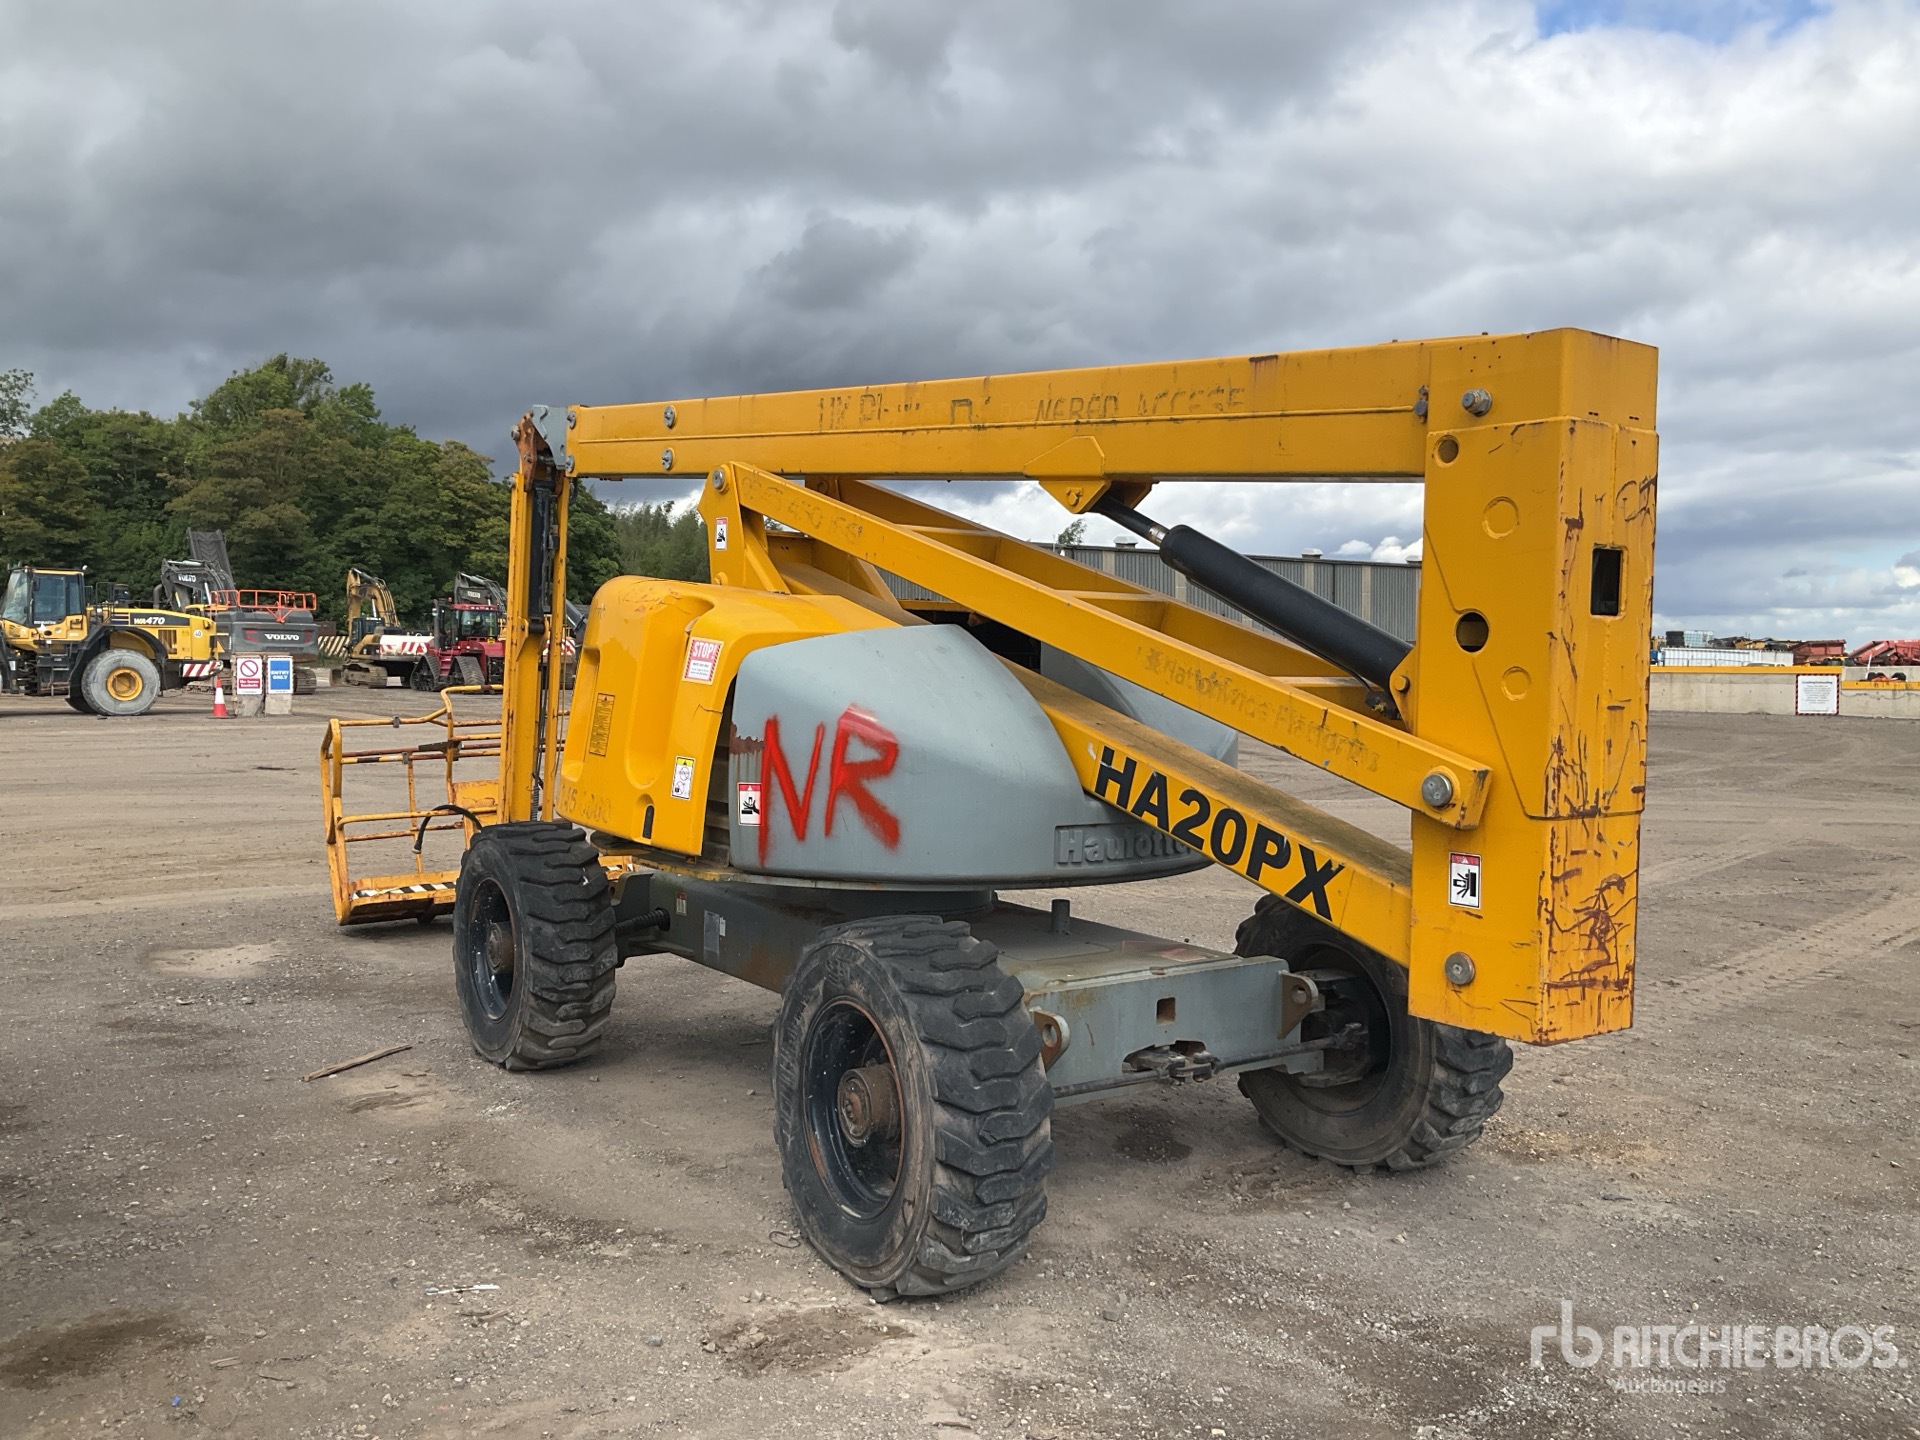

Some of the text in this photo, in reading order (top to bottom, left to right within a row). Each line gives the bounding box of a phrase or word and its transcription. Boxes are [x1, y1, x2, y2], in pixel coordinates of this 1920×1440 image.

[178, 574, 197, 583] VOLVO
[133, 616, 166, 625] WA470
[264, 633, 300, 641] VOLVO
[692, 641, 718, 660] STOP!
[758, 702, 901, 868] NR
[1094, 745, 1346, 922] HA20PX
